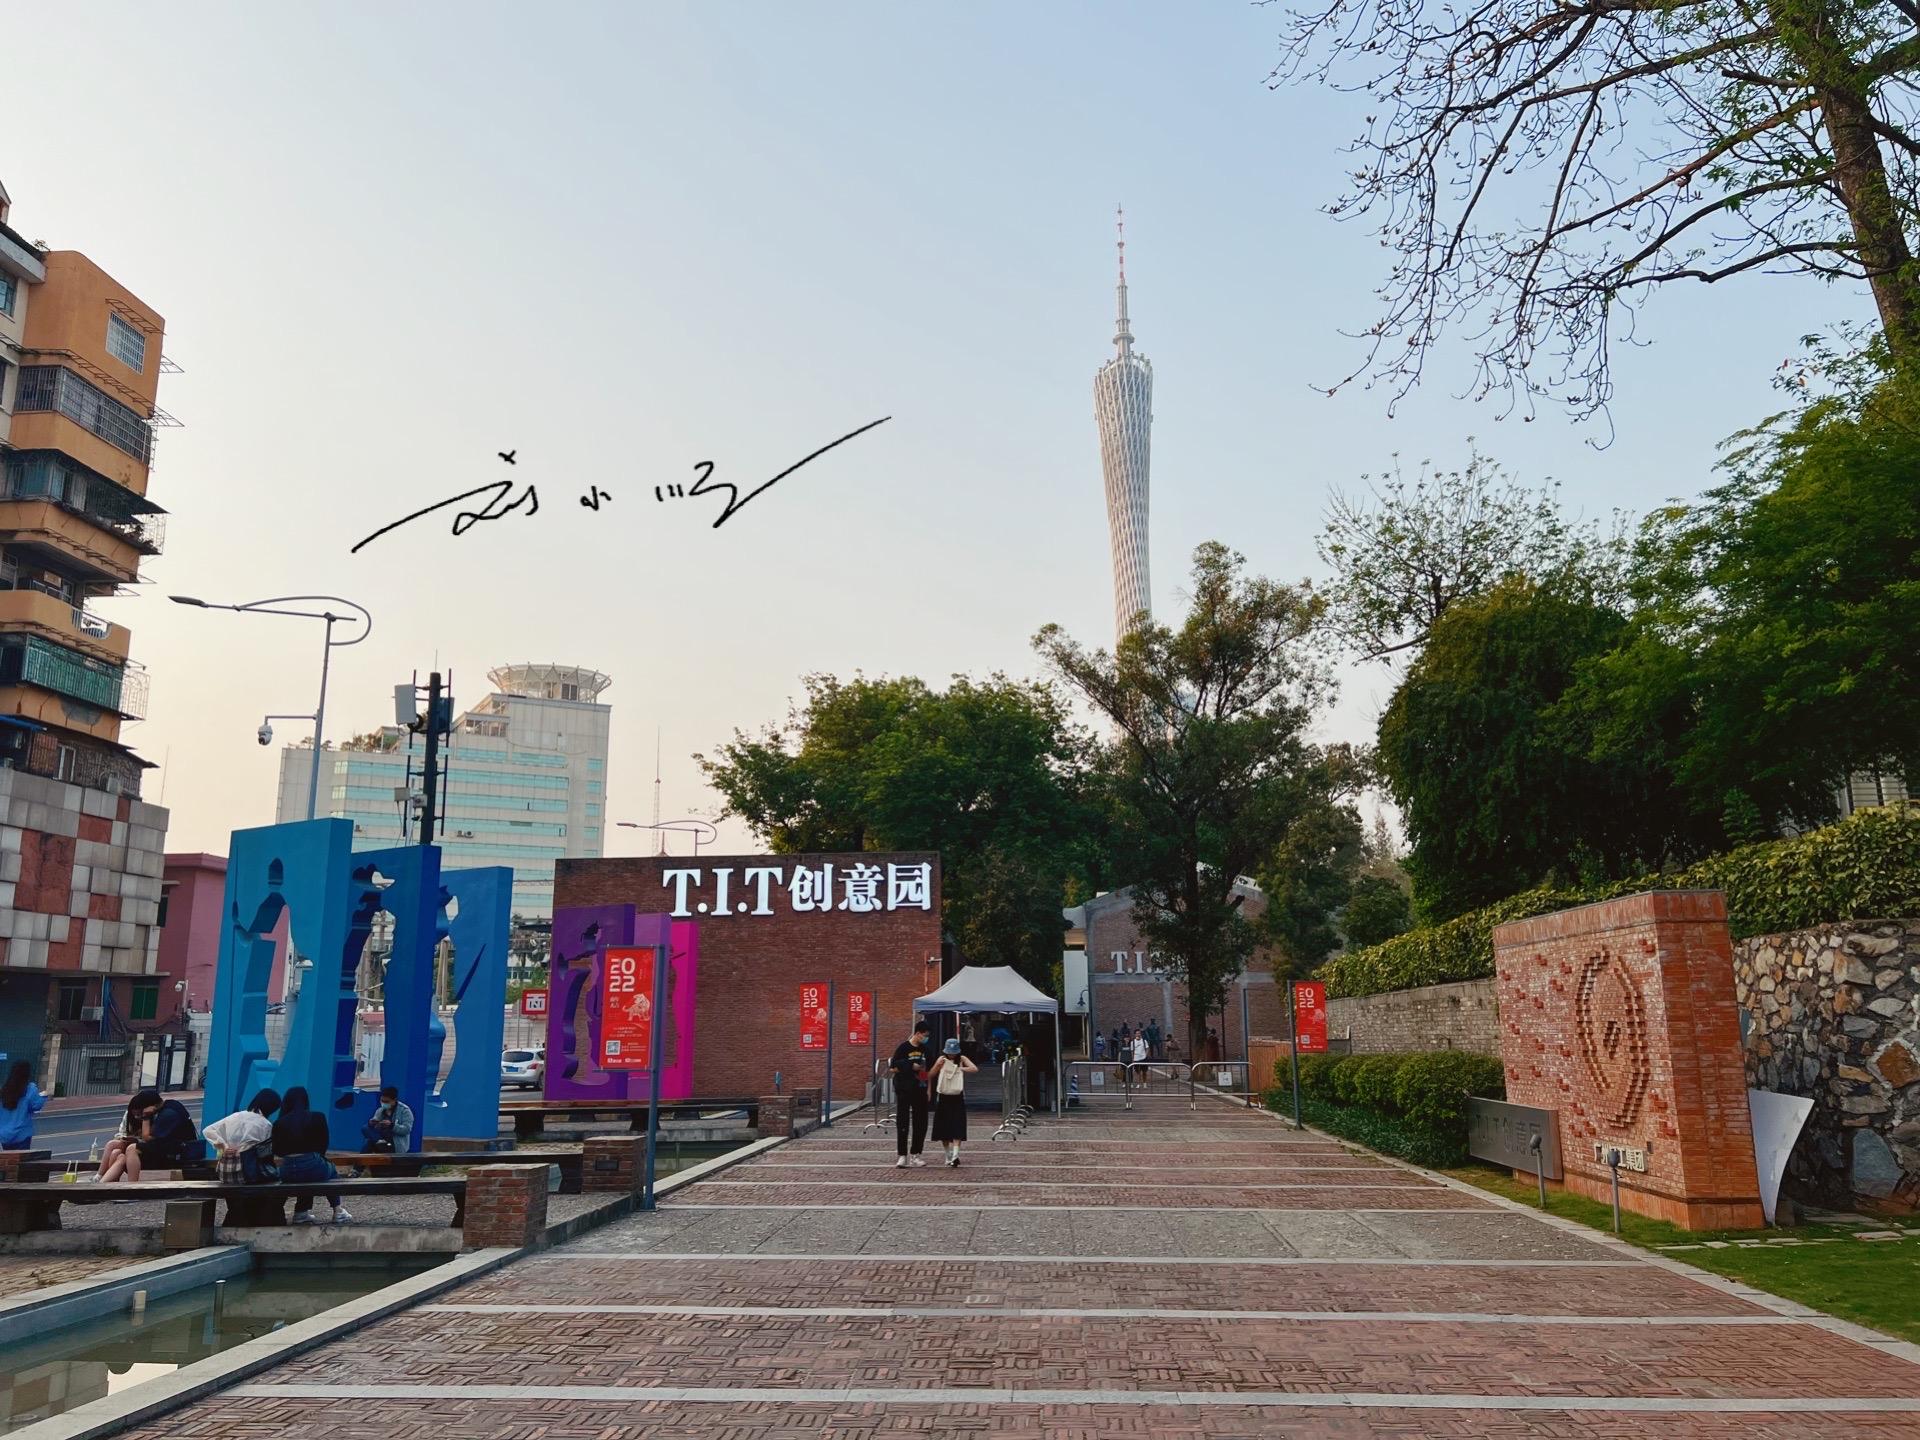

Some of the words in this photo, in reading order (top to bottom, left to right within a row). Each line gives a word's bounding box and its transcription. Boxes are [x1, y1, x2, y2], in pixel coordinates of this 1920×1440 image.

[662, 861, 932, 917] T.I.T创意园
[1593, 1141, 1646, 1172] 广州工集团
